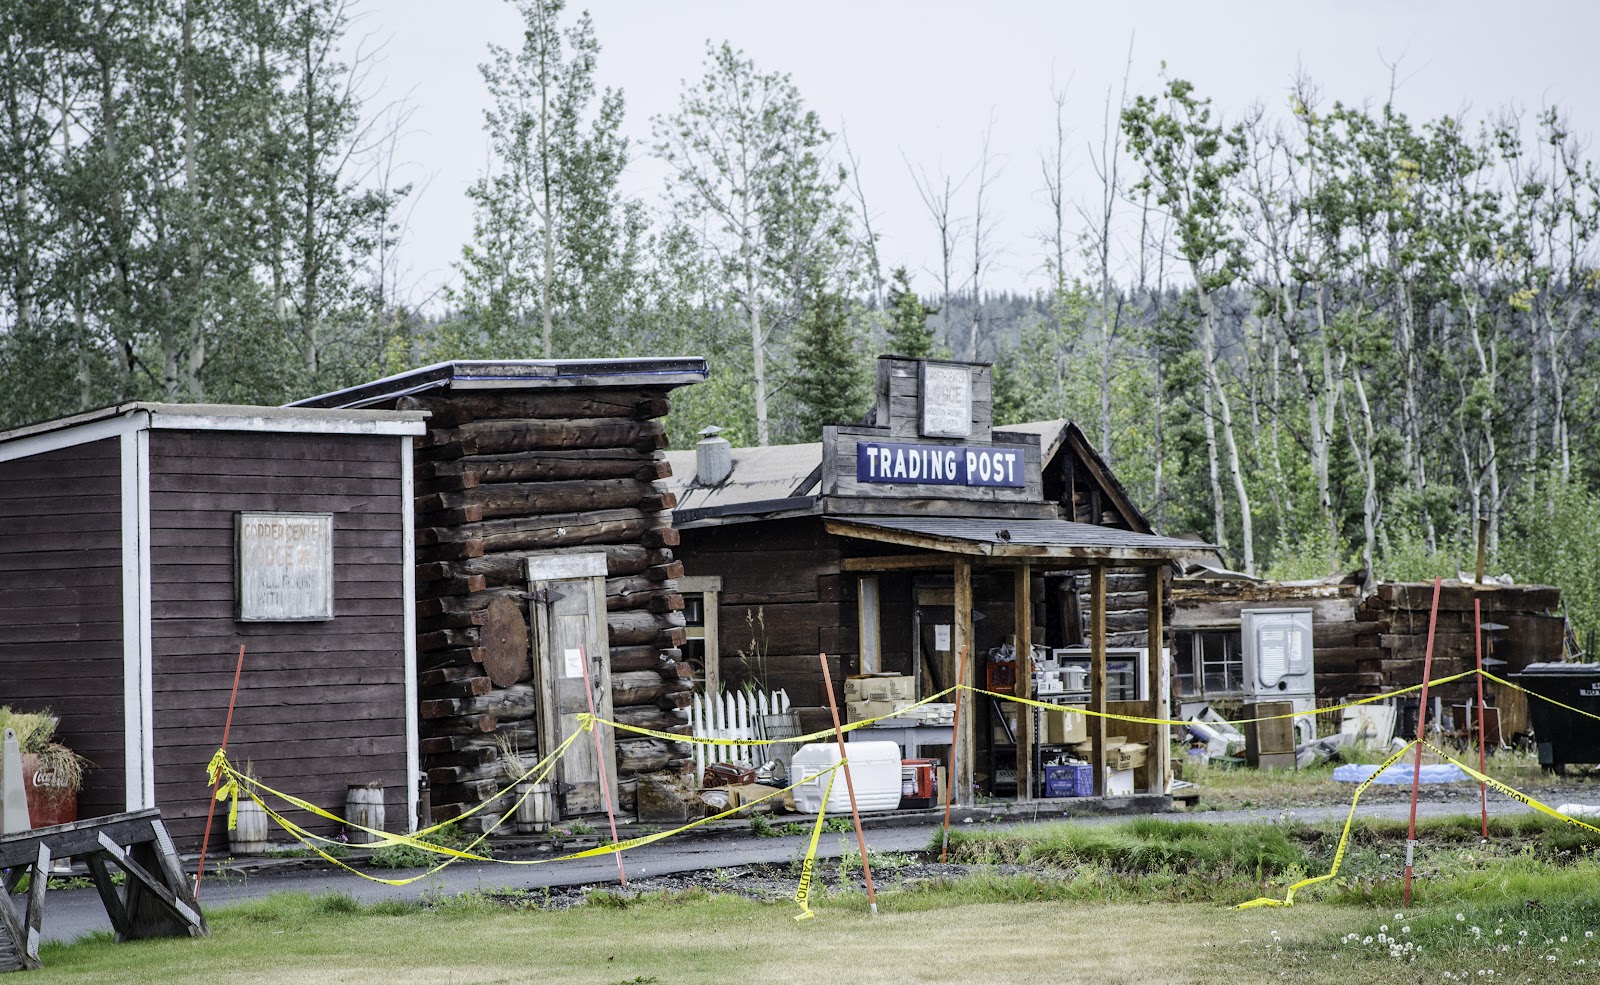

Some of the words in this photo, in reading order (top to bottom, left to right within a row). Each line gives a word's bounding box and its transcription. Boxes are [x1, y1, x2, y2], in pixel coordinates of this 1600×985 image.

[866, 447, 957, 480] TRADING
[966, 451, 1016, 482] POST
[286, 523, 322, 542] CENTE
[246, 546, 294, 568] ODGE
[1106, 661, 1129, 671] Snapple
[1484, 779, 1529, 805] CAUTION
